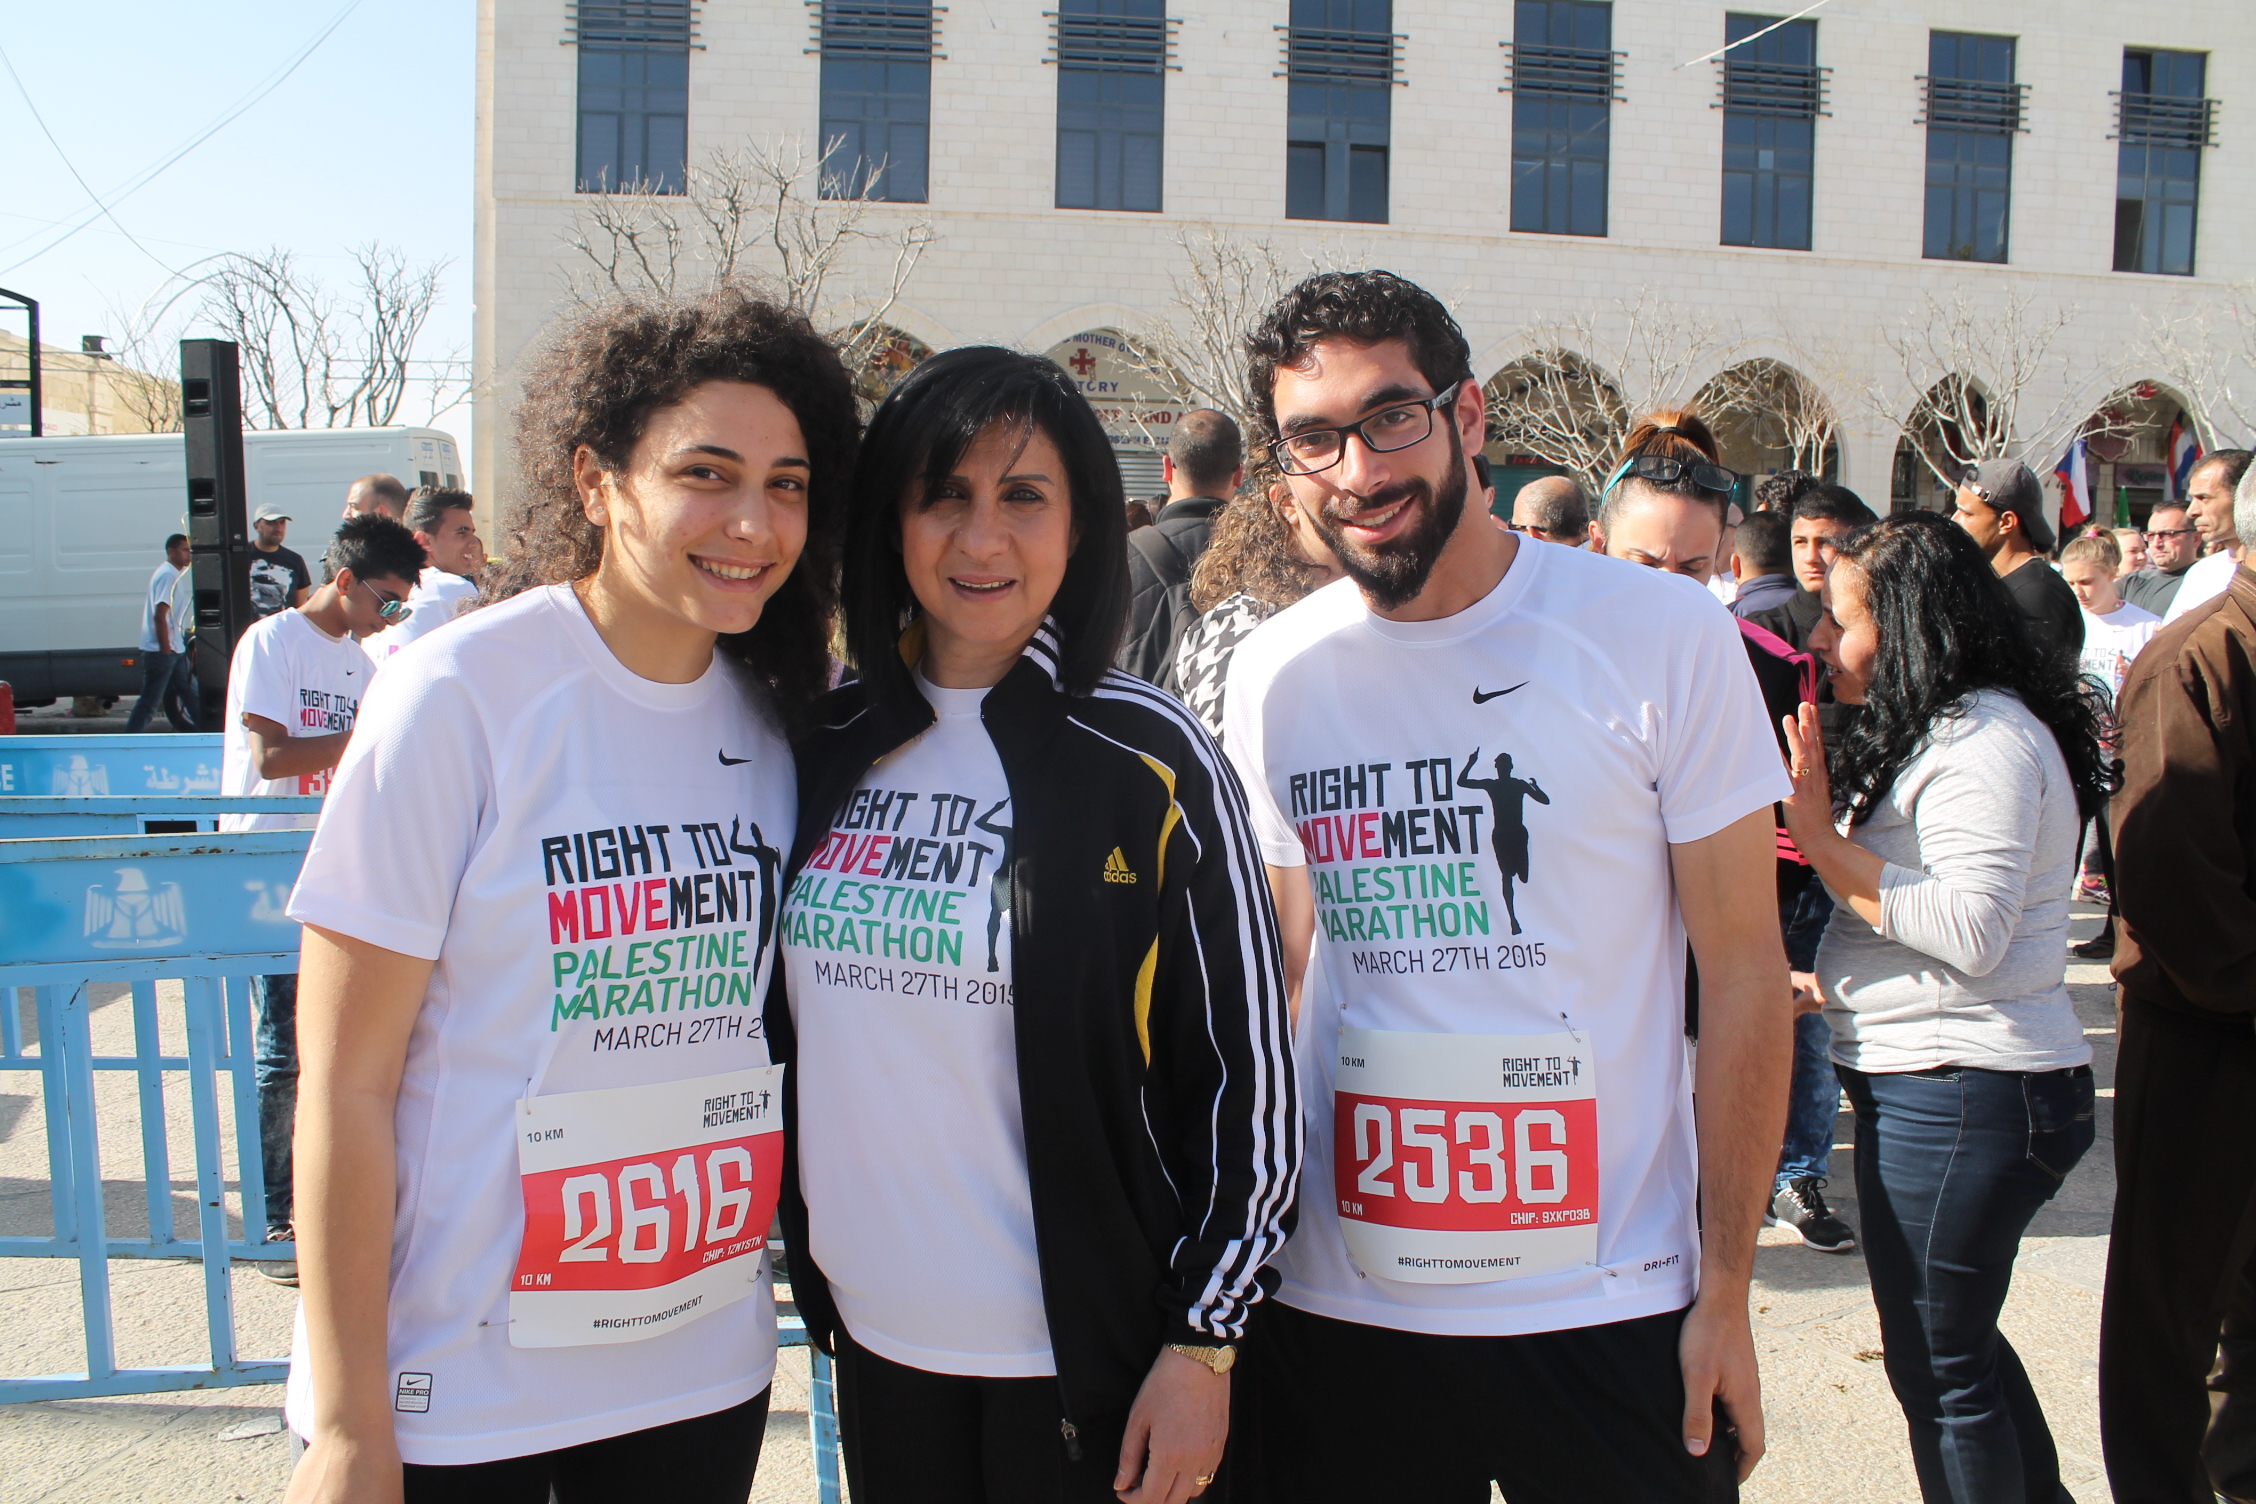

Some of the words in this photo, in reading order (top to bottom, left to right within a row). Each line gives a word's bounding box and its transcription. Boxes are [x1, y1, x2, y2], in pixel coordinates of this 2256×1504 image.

[1073, 333, 1116, 347] MOTHER
[1077, 381, 1119, 392] TORY
[2080, 659, 2114, 671] MENT
[300, 688, 330, 710] RIGHT
[334, 694, 346, 713] TO
[300, 708, 352, 731] MOVEMENT
[143, 763, 219, 795] لشرطة
[1290, 763, 1391, 817] RIGHT
[1406, 757, 1453, 804] TO
[834, 788, 918, 832] IGHT
[930, 793, 977, 836] TO
[1296, 805, 1483, 865] MOVEMENT
[541, 824, 671, 886] RIGHT
[681, 822, 732, 869] TO
[548, 870, 755, 945] MOVEMENT
[784, 874, 967, 925] PALESTINE
[780, 911, 963, 966] MARATHON
[553, 930, 749, 989] PALESTINE
[1353, 948, 1424, 974] MARCH
[1432, 946, 1489, 972] 27TH
[1498, 942, 1546, 970] 2015
[815, 960, 894, 992] MARCH
[902, 970, 958, 1001] 27TH
[551, 972, 752, 1032] MARATHON
[593, 1022, 683, 1052] MARCH
[688, 1015, 743, 1044] 27TH
[1341, 1056, 1350, 1066] 10
[1351, 1057, 1365, 1068] KM
[1502, 1057, 1541, 1072] RIGHT
[1545, 1056, 1561, 1071] TO
[1503, 1070, 1570, 1088] MOVEMENT
[704, 1093, 737, 1113] RIGHT
[740, 1091, 754, 1106] TO
[703, 1104, 761, 1128] MOVEMENT
[526, 1131, 542, 1143] 10
[544, 1127, 564, 1141] KM
[1353, 1103, 1569, 1204] 2536
[558, 1146, 753, 1264] 2616
[1341, 1200, 1350, 1213] 10
[1352, 1202, 1363, 1216] KM
[1510, 1212, 1539, 1225] CHIP:
[702, 1247, 725, 1263] CHIP:
[1397, 1256, 1521, 1269] #RIGHTTOMOVEMENT
[1643, 1254, 1679, 1272] DRI-FIT
[520, 1273, 533, 1286] 10
[536, 1273, 552, 1286] KM
[593, 1294, 704, 1328] #RIGHTTOMOVEMENT
